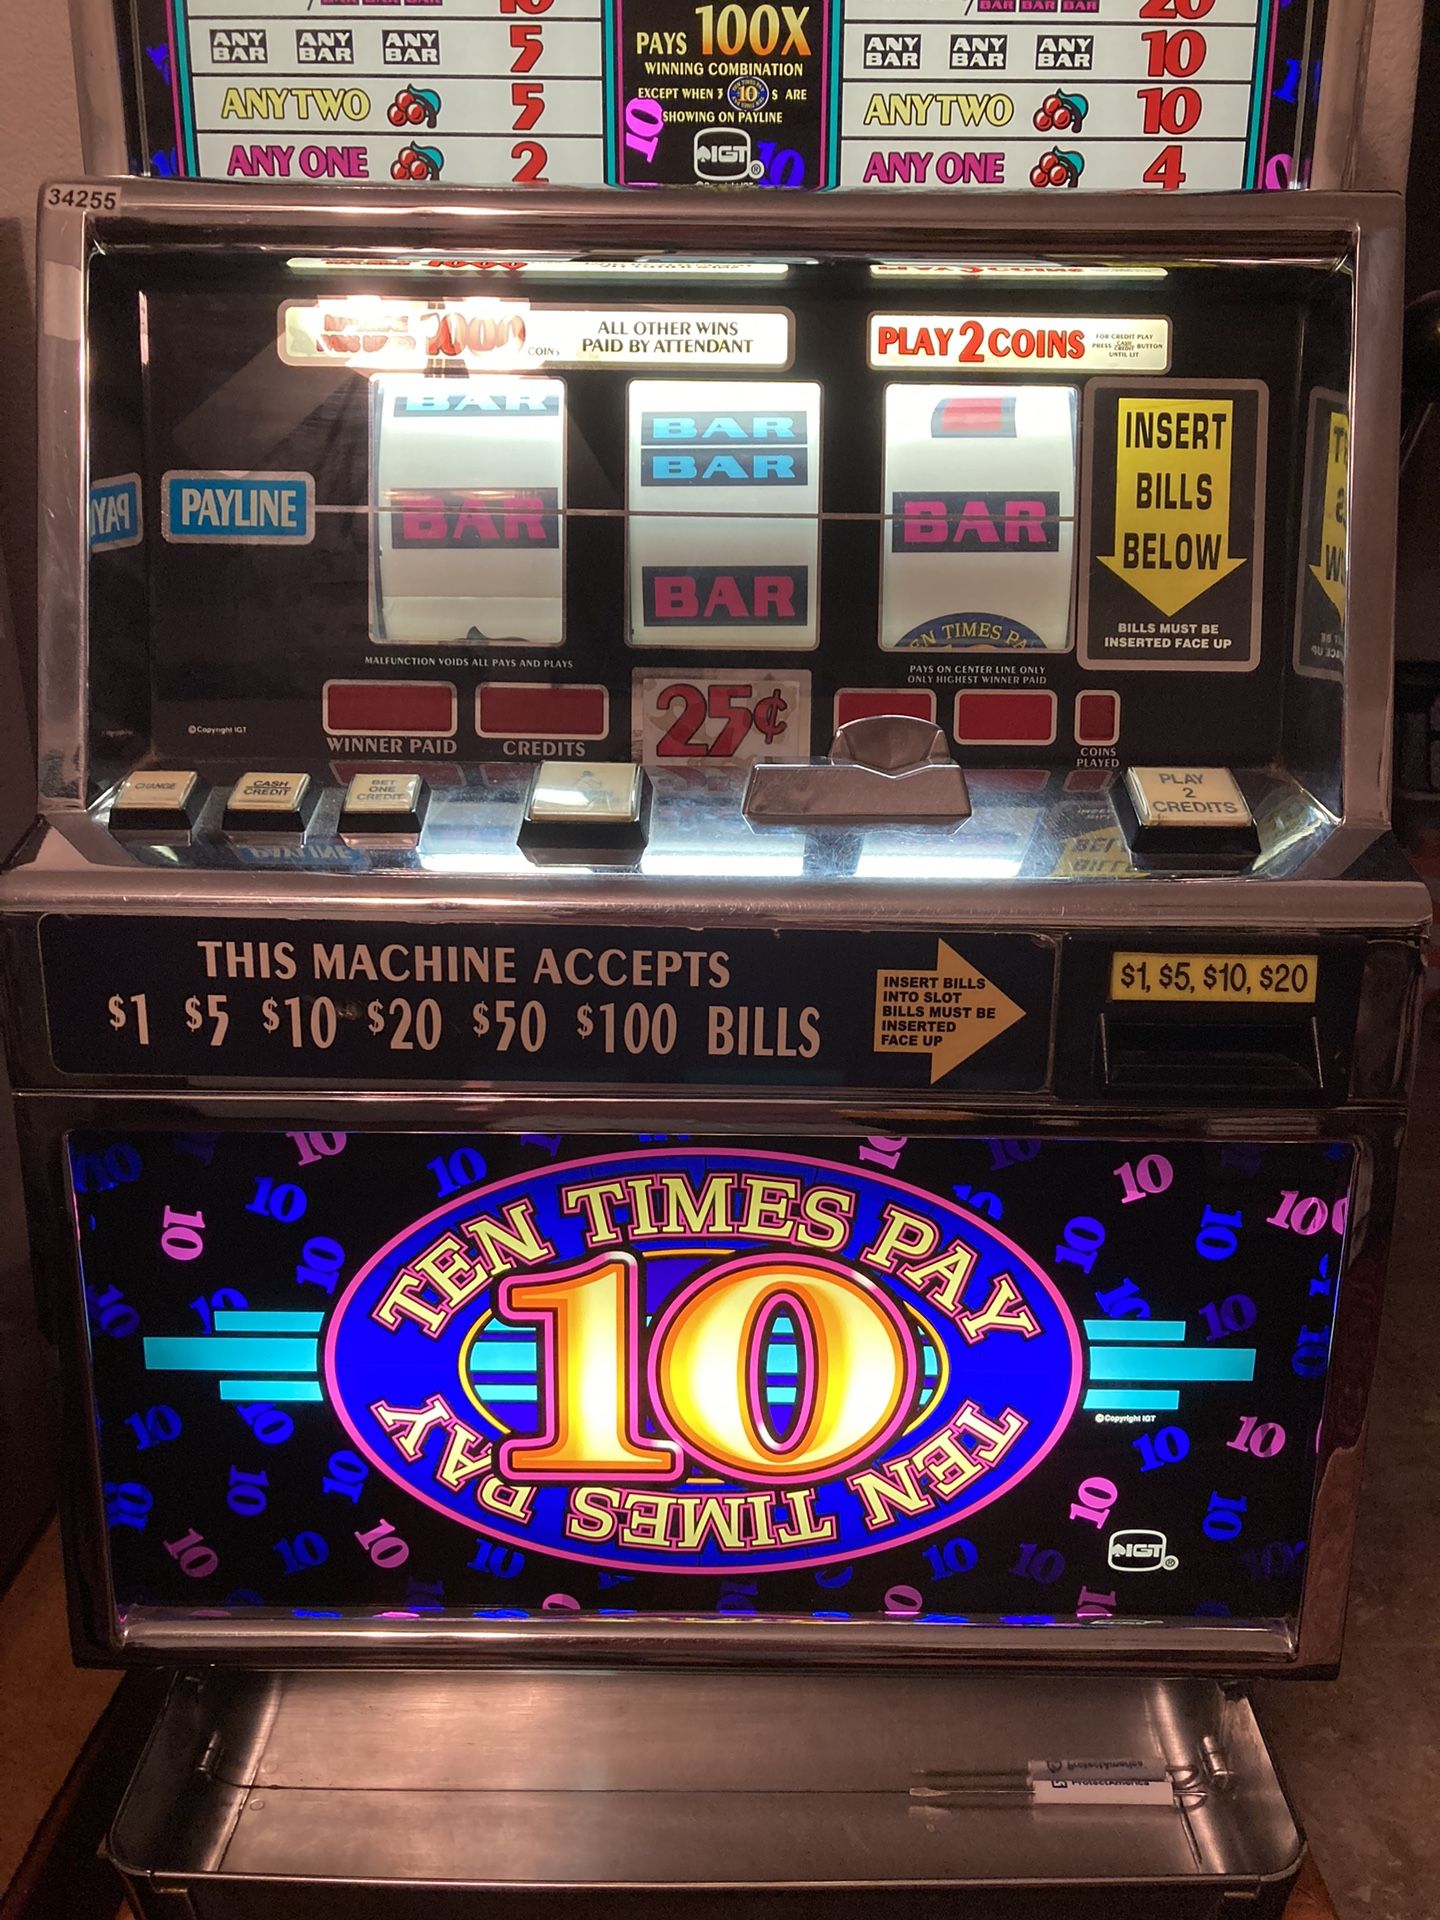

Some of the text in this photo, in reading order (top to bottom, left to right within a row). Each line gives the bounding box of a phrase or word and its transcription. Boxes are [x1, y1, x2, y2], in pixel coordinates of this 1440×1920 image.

[636, 4, 812, 56] PAYS 100X
[213, 32, 264, 46] ANY
[300, 32, 350, 46] ANY
[385, 33, 438, 47] ANY
[866, 37, 918, 51] ANY
[952, 37, 1005, 51] ANY
[1039, 38, 1091, 52] ANY
[212, 48, 266, 62] BAR
[299, 48, 352, 62] BAR
[385, 49, 438, 62] BAR
[510, 24, 544, 73] 5
[1141, 29, 1207, 77] 10
[865, 52, 918, 67] BAR
[951, 53, 1004, 67] BAR
[1038, 53, 1090, 68] BAR
[645, 62, 803, 76] WINNING COMBINATION
[638, 87, 678, 99] EXCEPT
[682, 88, 714, 99] WHEN
[717, 88, 723, 99] 3
[738, 85, 758, 101] 10
[771, 88, 778, 100] S
[785, 88, 807, 100] ARE
[512, 83, 545, 130] 5
[1137, 87, 1202, 135] 10
[663, 111, 783, 123] SHOWING ON PAYLINE
[625, 98, 664, 163] 10
[227, 141, 549, 182] ANY ONE 2
[863, 145, 1186, 189] ANY ONE 4
[48, 188, 117, 210] 34255
[598, 321, 738, 336] ALL OTHER WINS
[582, 338, 754, 354] PAID BY ATTENDANT
[878, 320, 1085, 362] PLAY 2 COINS
[652, 417, 796, 438] BAR
[1125, 412, 1227, 450] INSERT
[652, 455, 796, 479] BAR
[1136, 473, 1212, 510] BILLS
[181, 488, 297, 527] PAYLINE
[402, 498, 547, 540] BAR
[903, 500, 1047, 543] BAR
[1123, 533, 1222, 570] BELOW
[654, 575, 796, 619] BAR
[941, 621, 1004, 641] TIMES
[1118, 622, 1219, 634] BILLS MUST BE
[1104, 637, 1232, 649] INSERTED FACE UP
[365, 656, 574, 669] MALFUNCTION VOIDS ALL PAYS AND PLAYS
[909, 665, 1046, 674] PAYS ON CENTER LINE ONLY
[907, 675, 1047, 684] ONLY HIGHEST WINNER PAID
[656, 683, 788, 758] 25¢
[327, 737, 457, 754] WINNER PAID
[502, 740, 586, 757] CREDITS
[1080, 747, 1117, 757] COINS
[1076, 758, 1120, 768] PLAYED
[134, 782, 177, 790] CHANGE
[1159, 773, 1204, 785] PLAY
[243, 788, 290, 796] CREDIT
[356, 793, 404, 801] CREDIT
[1182, 787, 1196, 798] 2
[1153, 801, 1238, 814] CREDITS
[197, 941, 730, 988] THIS MACHINE ACCEPTS
[884, 976, 986, 989] INSERT BILLS
[1121, 962, 1308, 994] $1, $5, $10, $20
[883, 991, 962, 1003] INTO SLOT
[882, 1006, 996, 1019] BILLS MUST BE
[108, 993, 821, 1058] $1 $5 $10 $20 $50 $100 BILLS
[882, 1020, 956, 1032] INSERTED
[881, 1035, 943, 1046] FACE UP
[1114, 1154, 1174, 1204] 10
[246, 1176, 307, 1223] 10
[1055, 1216, 1106, 1274] 10
[372, 1173, 1041, 1344] TEN TIMES PAY
[500, 1250, 917, 1485] 10
[370, 1394, 1029, 1553] TEN TIMES PAY
[1069, 1477, 1118, 1530] 10
[354, 1518, 410, 1569] 10
[1125, 1544, 1163, 1558] IGT
